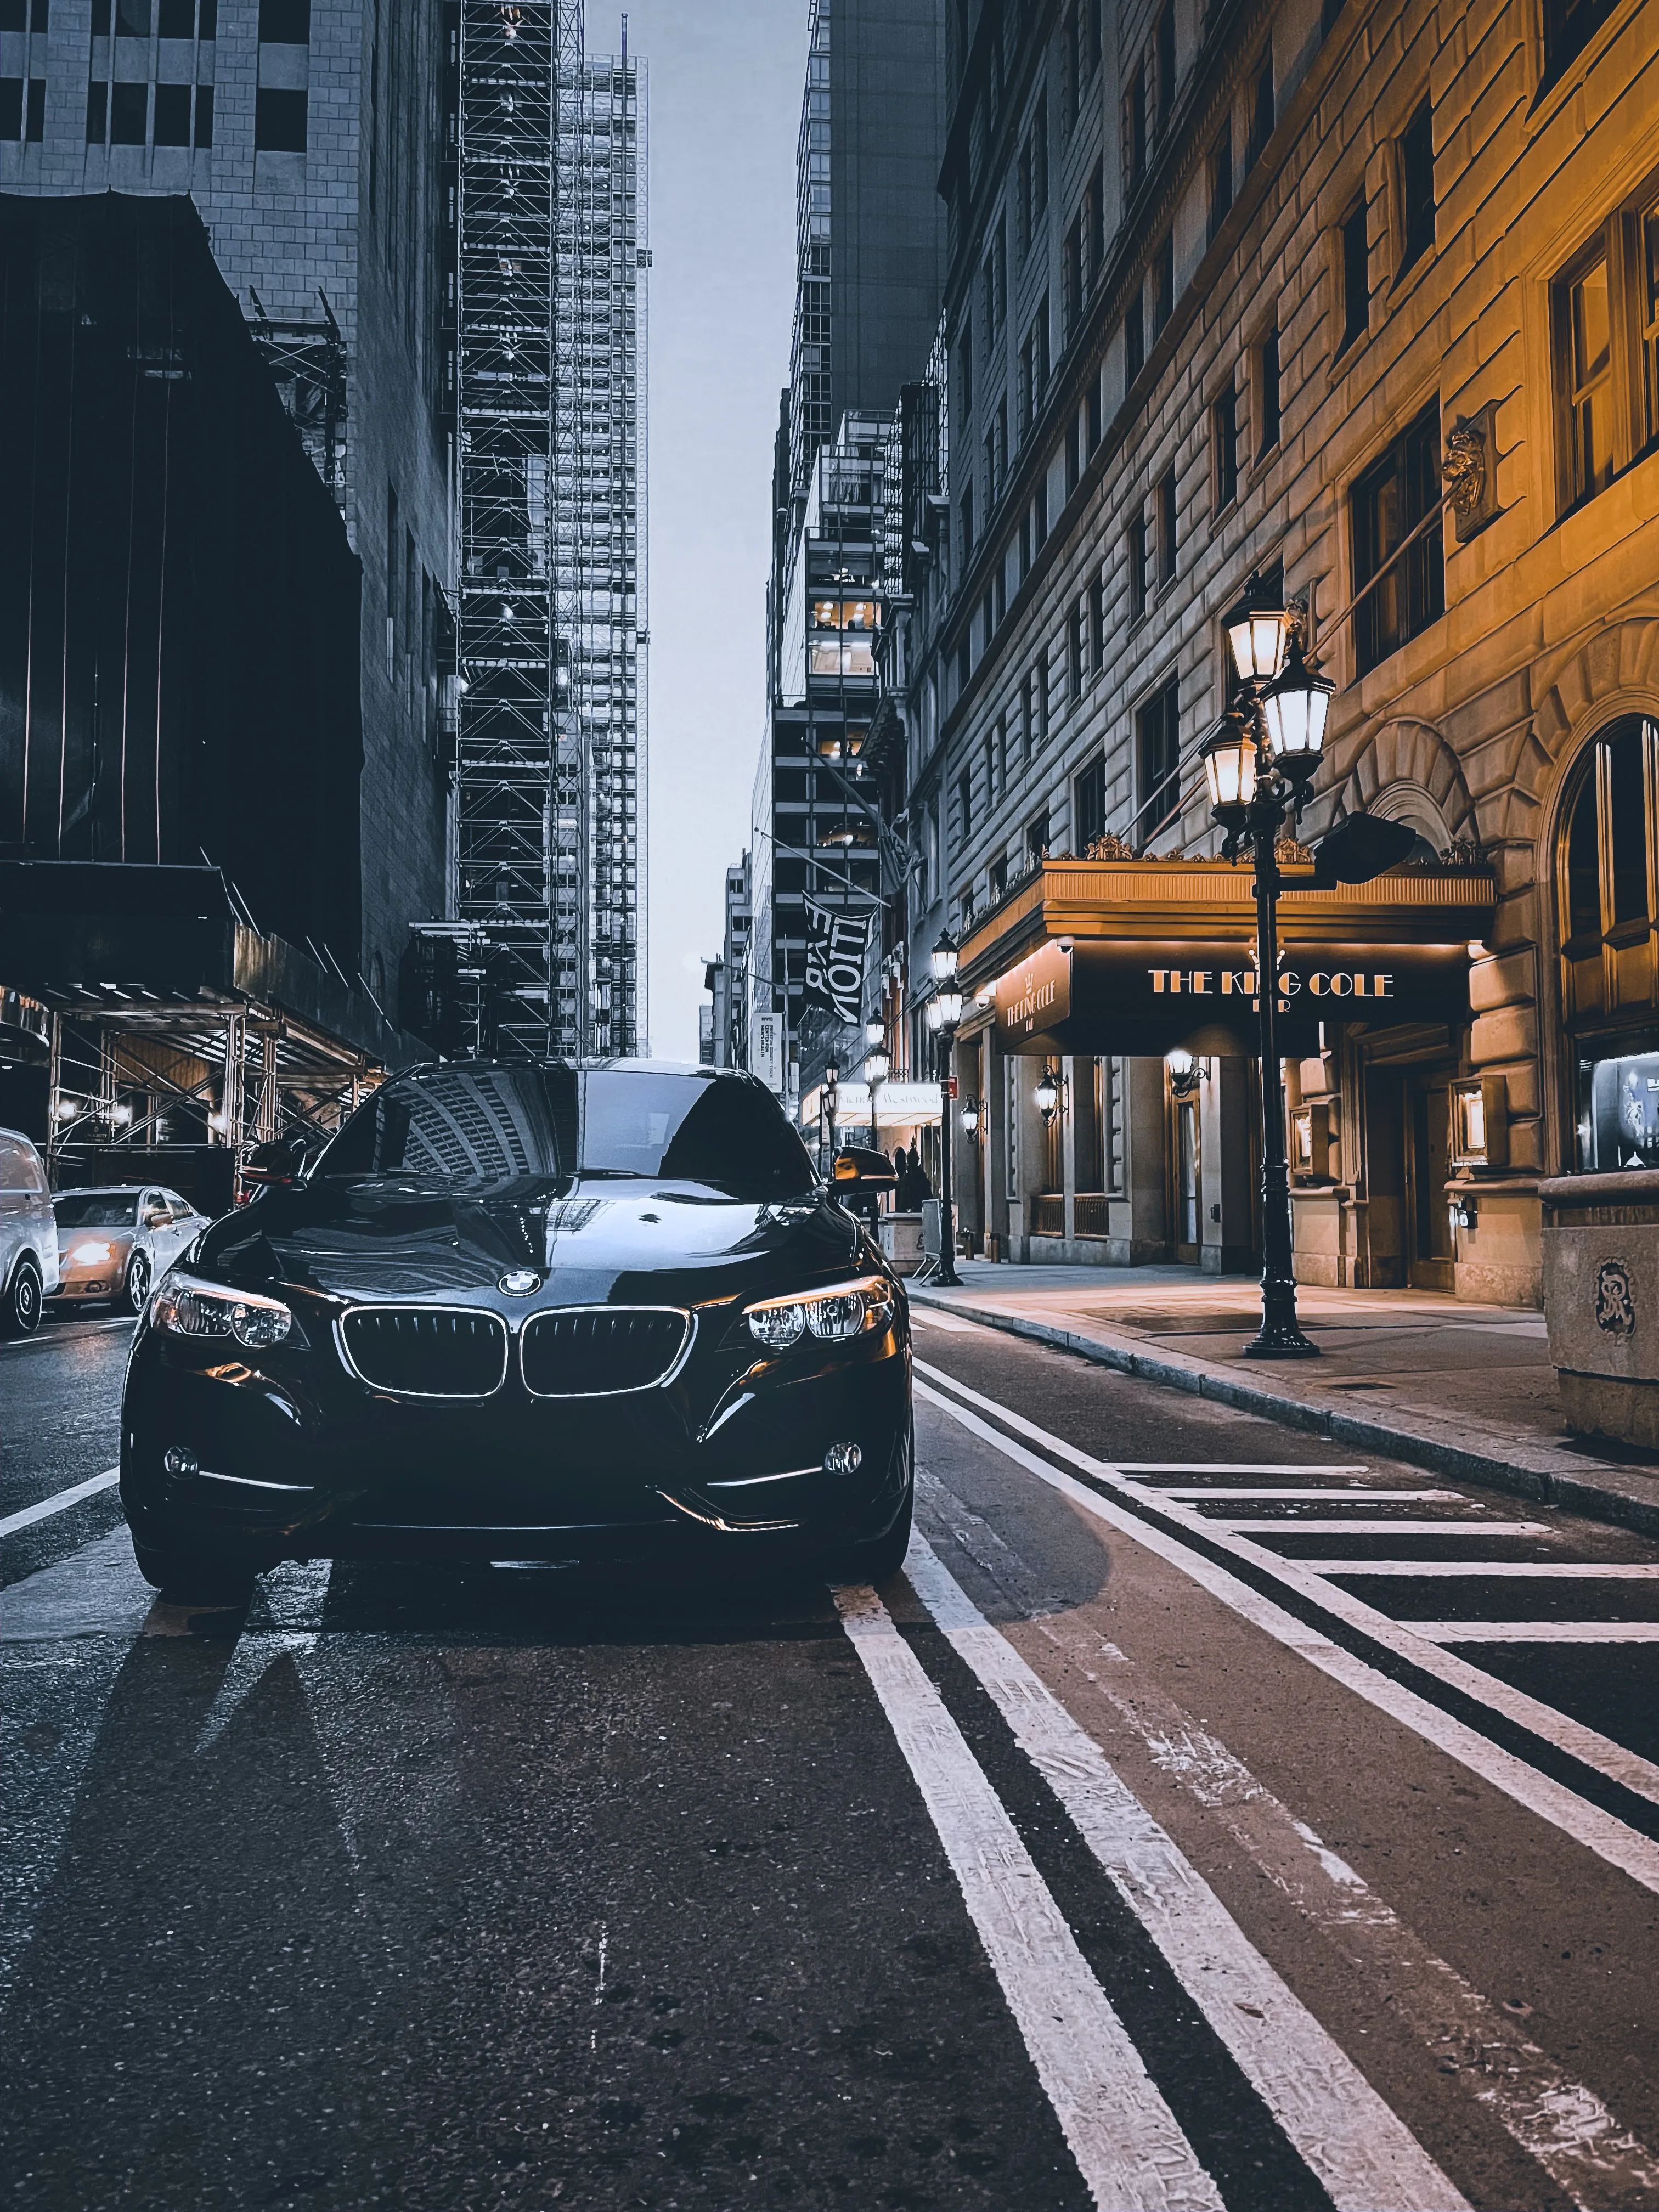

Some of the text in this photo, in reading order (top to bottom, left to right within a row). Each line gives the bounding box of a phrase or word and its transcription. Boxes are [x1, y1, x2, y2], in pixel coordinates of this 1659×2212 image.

[1147, 970, 1394, 997] THE KIG COLE
